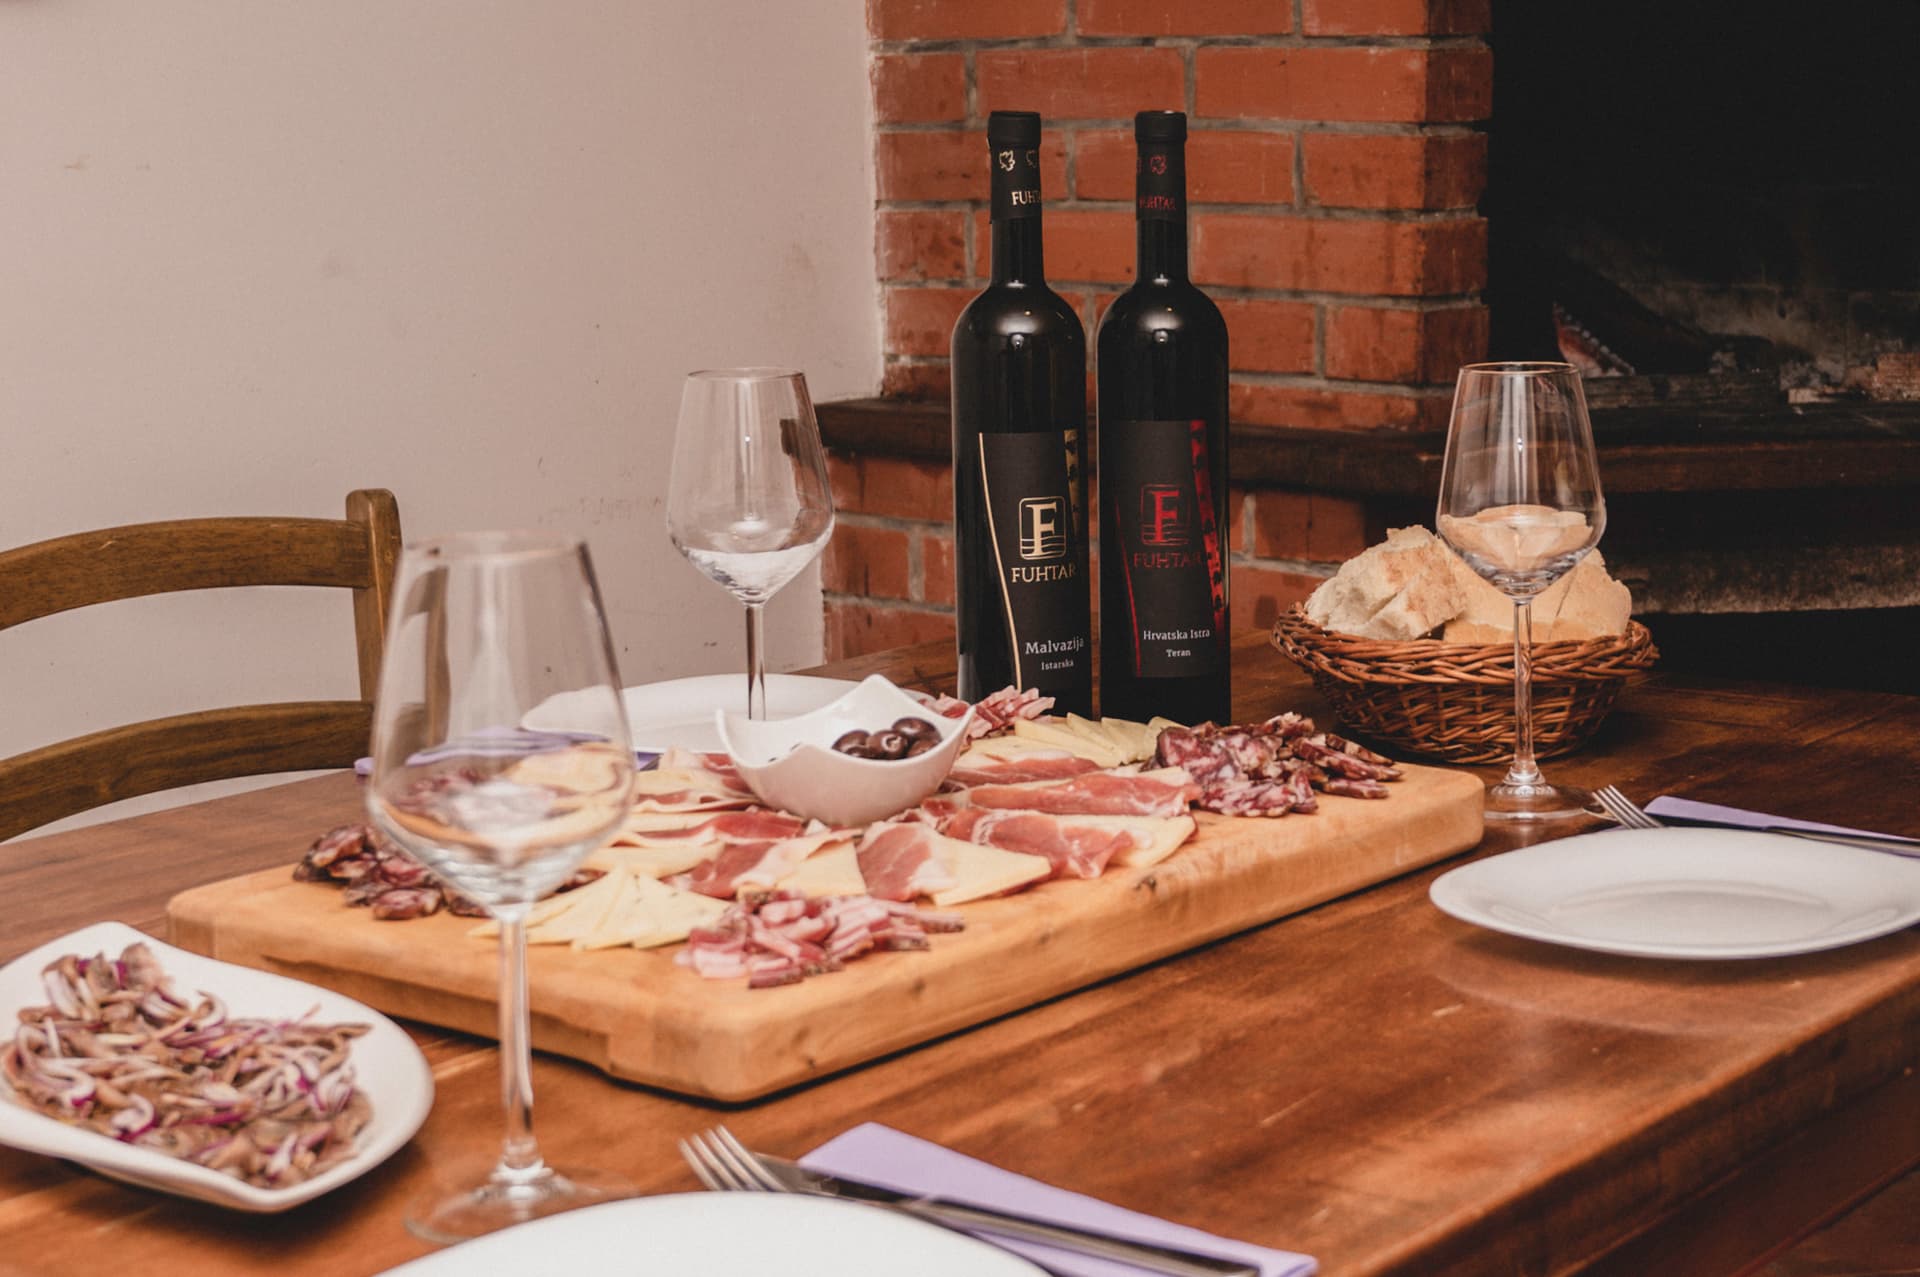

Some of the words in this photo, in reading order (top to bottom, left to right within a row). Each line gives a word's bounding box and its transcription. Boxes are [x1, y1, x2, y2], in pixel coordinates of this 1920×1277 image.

[1152, 490, 1179, 543] F
[1025, 501, 1057, 555] F
[1133, 551, 1203, 569] FUHTAR
[1011, 564, 1077, 583] FUHTAR
[1143, 629, 1188, 641] Hrvatska
[1190, 628, 1211, 639] Istra
[1025, 636, 1084, 655] Malvazija
[1166, 649, 1191, 657] Teran
[1041, 658, 1074, 670] Istarska
